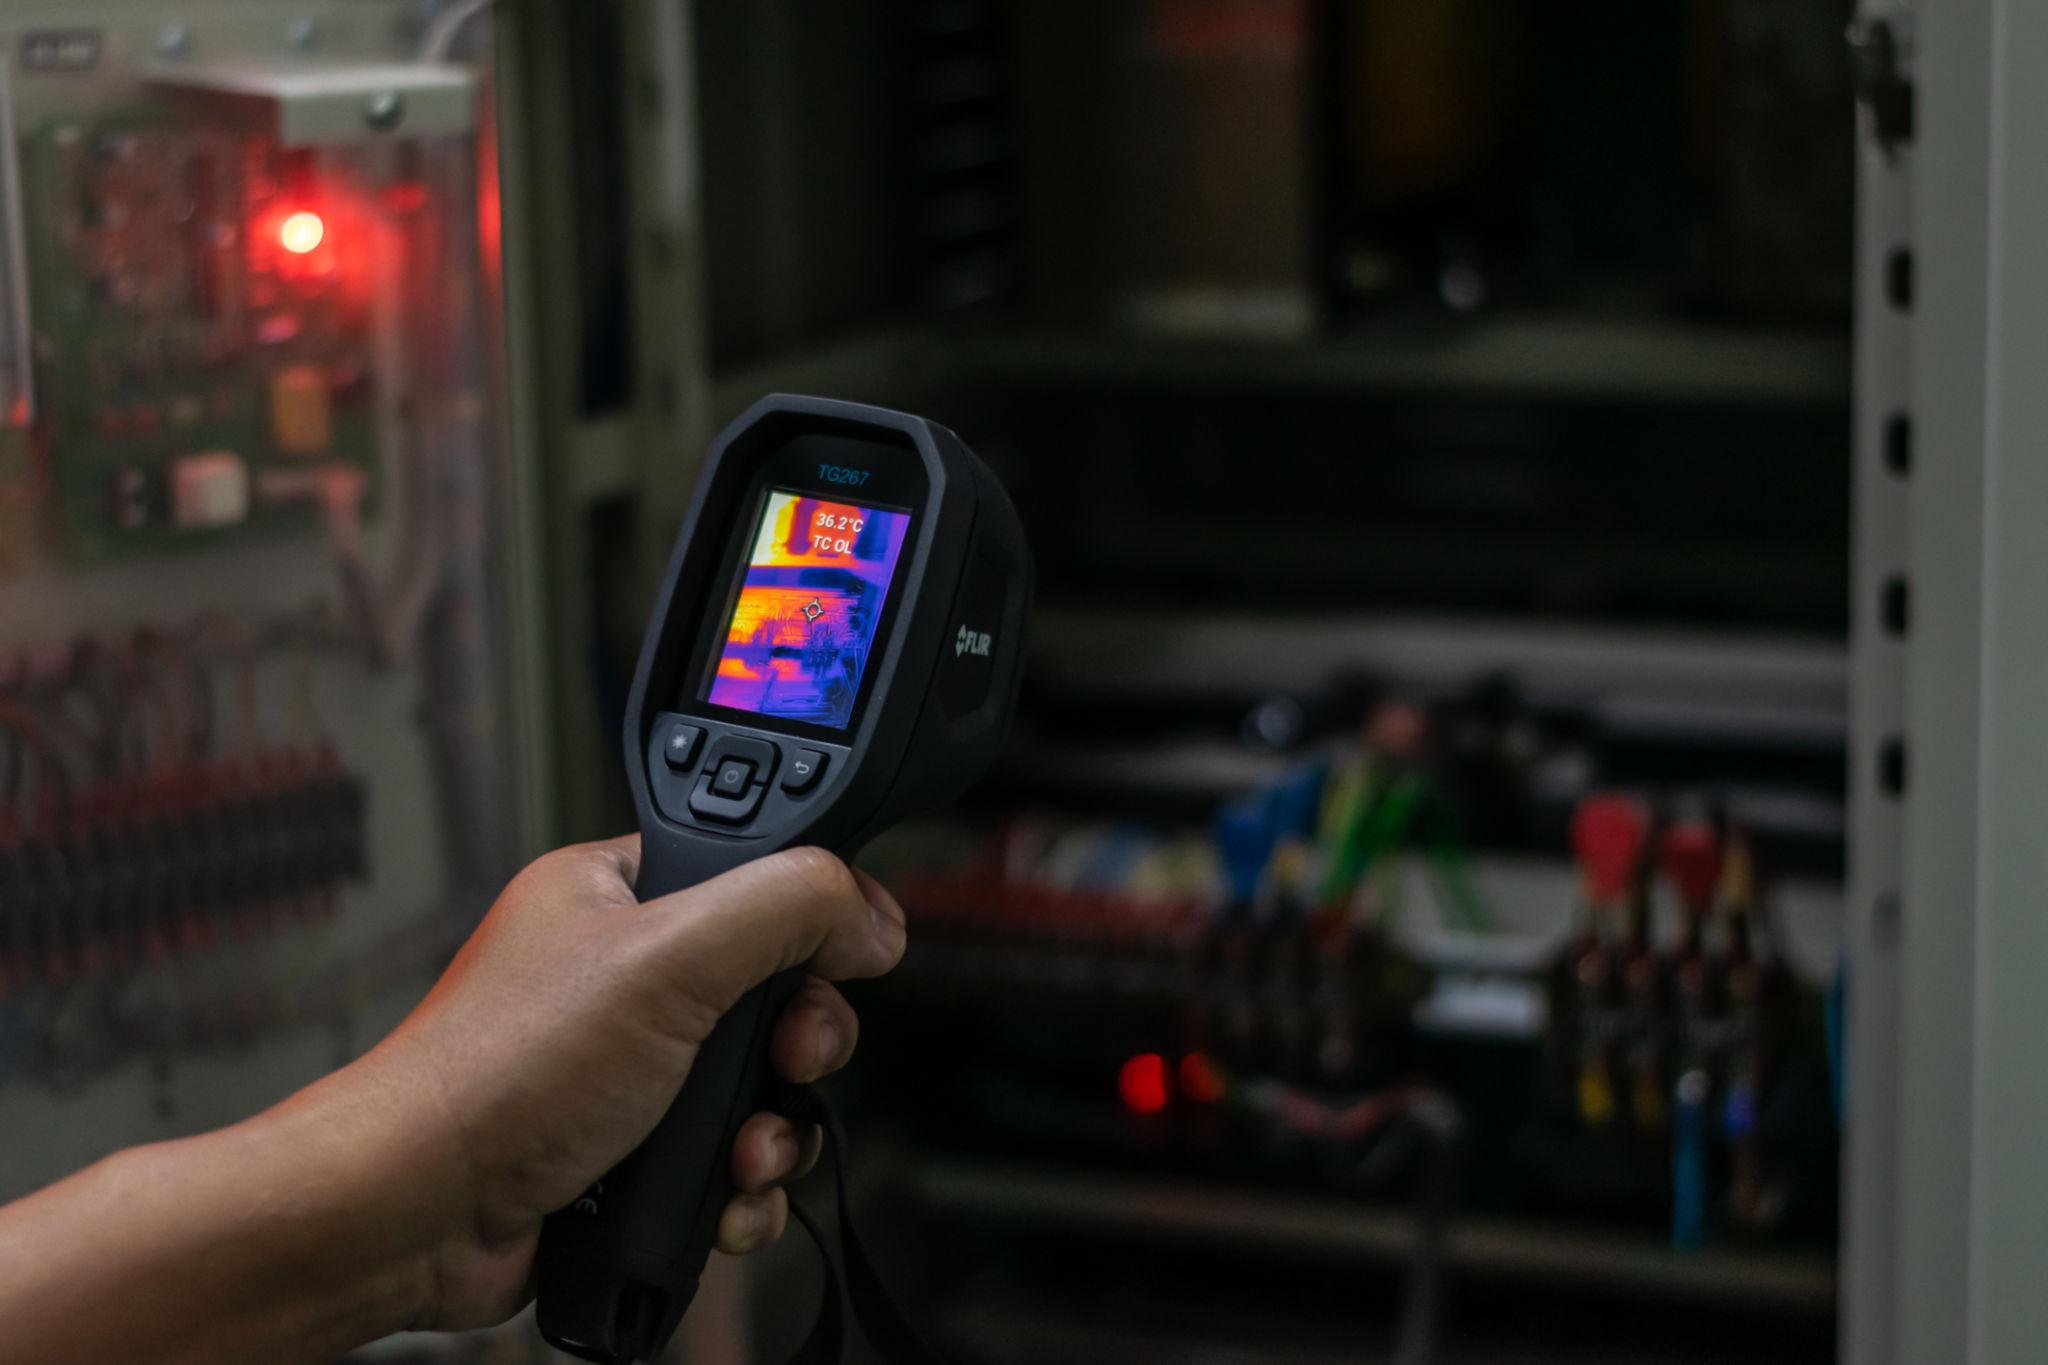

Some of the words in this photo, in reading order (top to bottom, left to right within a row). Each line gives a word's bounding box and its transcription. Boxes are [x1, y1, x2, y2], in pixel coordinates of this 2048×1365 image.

[819, 464, 870, 486] TG267
[816, 512, 864, 533] 36.2°C
[814, 535, 832, 550] TC
[834, 539, 852, 554] OL
[963, 629, 991, 657] FLIR
